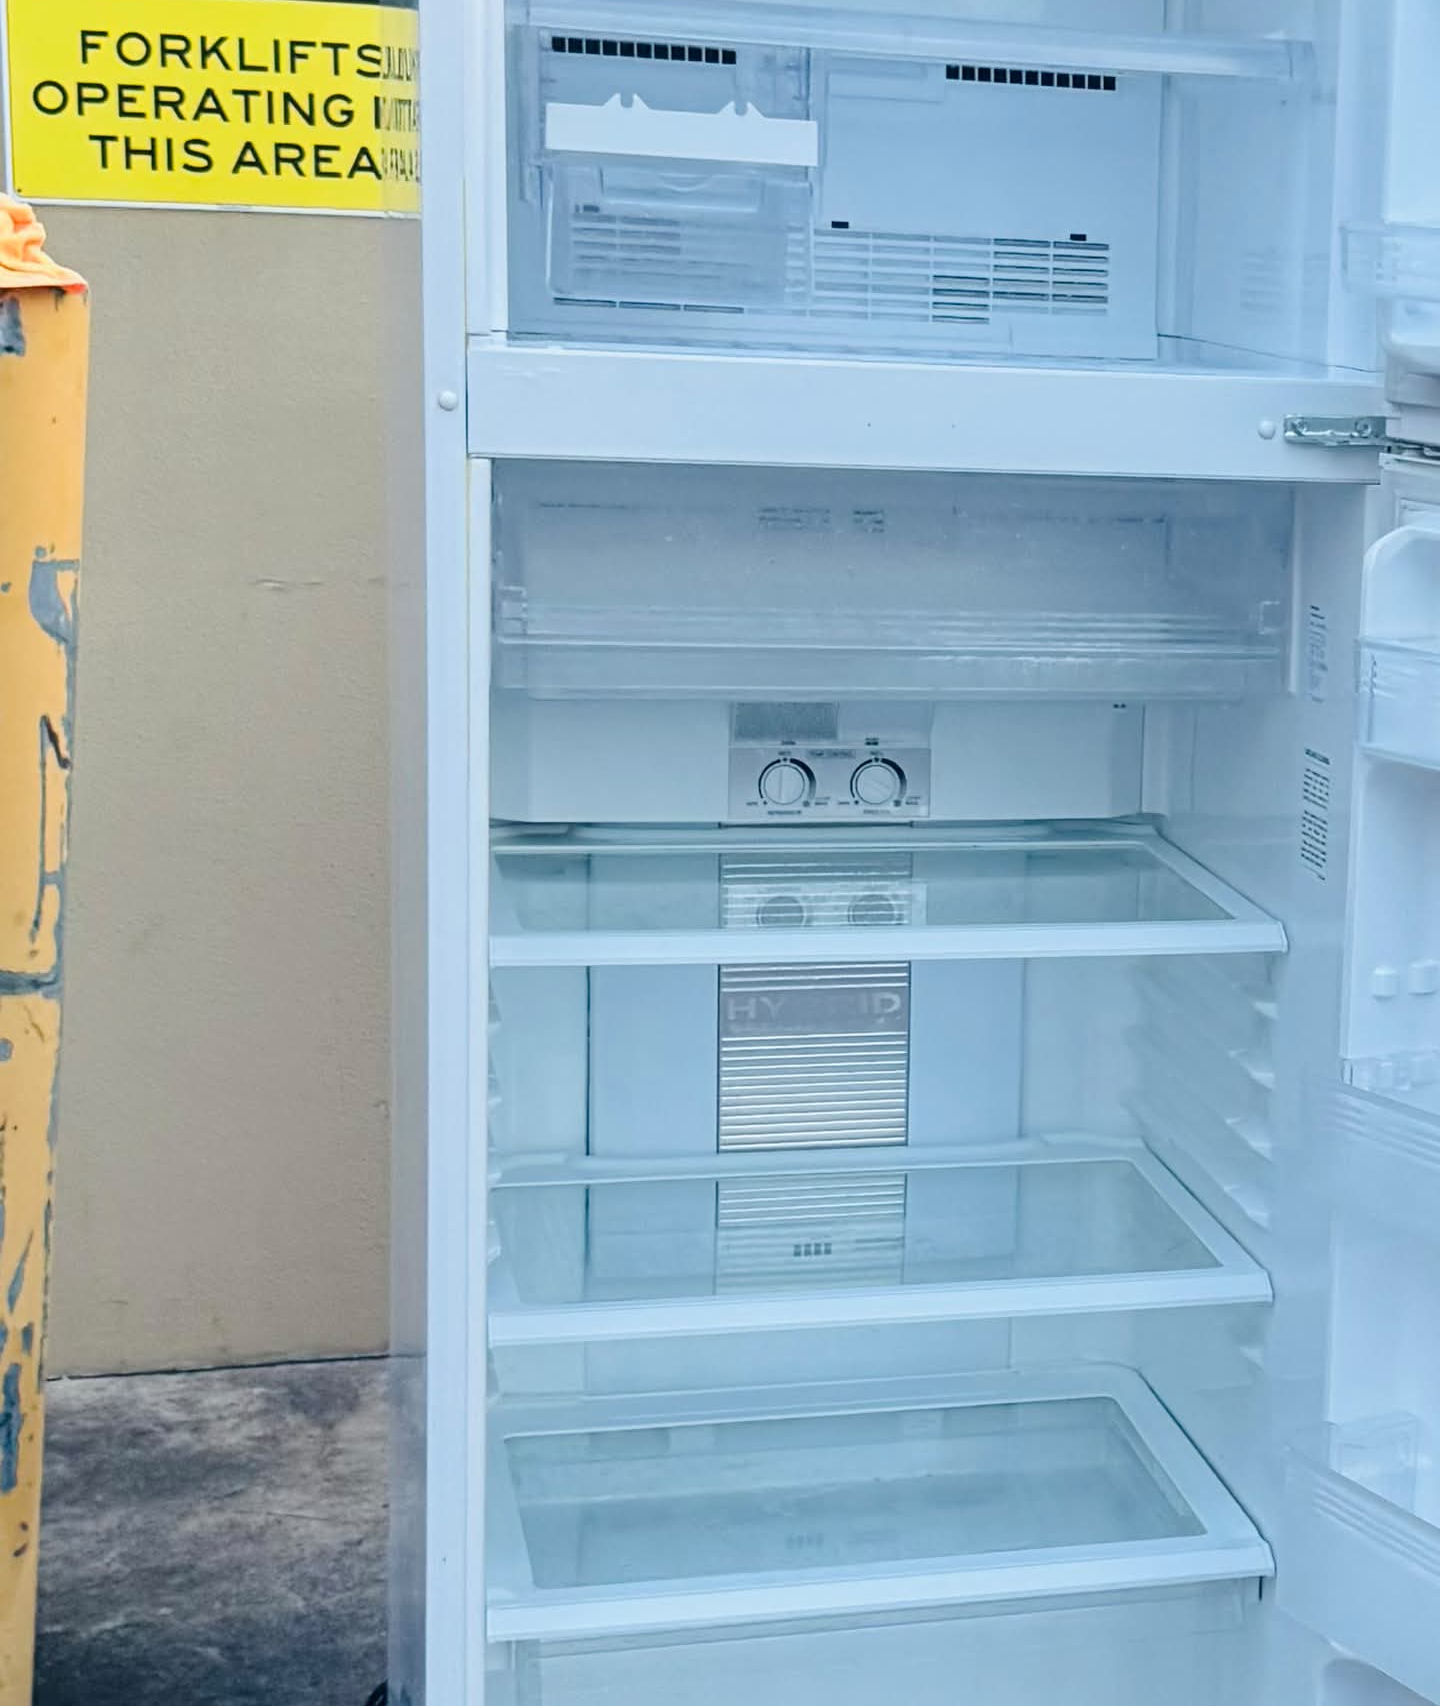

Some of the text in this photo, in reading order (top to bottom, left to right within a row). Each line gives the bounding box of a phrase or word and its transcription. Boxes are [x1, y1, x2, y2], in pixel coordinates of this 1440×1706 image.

[80, 29, 382, 78] FORKLIFTS
[32, 80, 355, 129] OPERATING
[88, 134, 213, 173] THIS
[231, 140, 383, 181] AREA
[727, 992, 901, 1021] HYID
